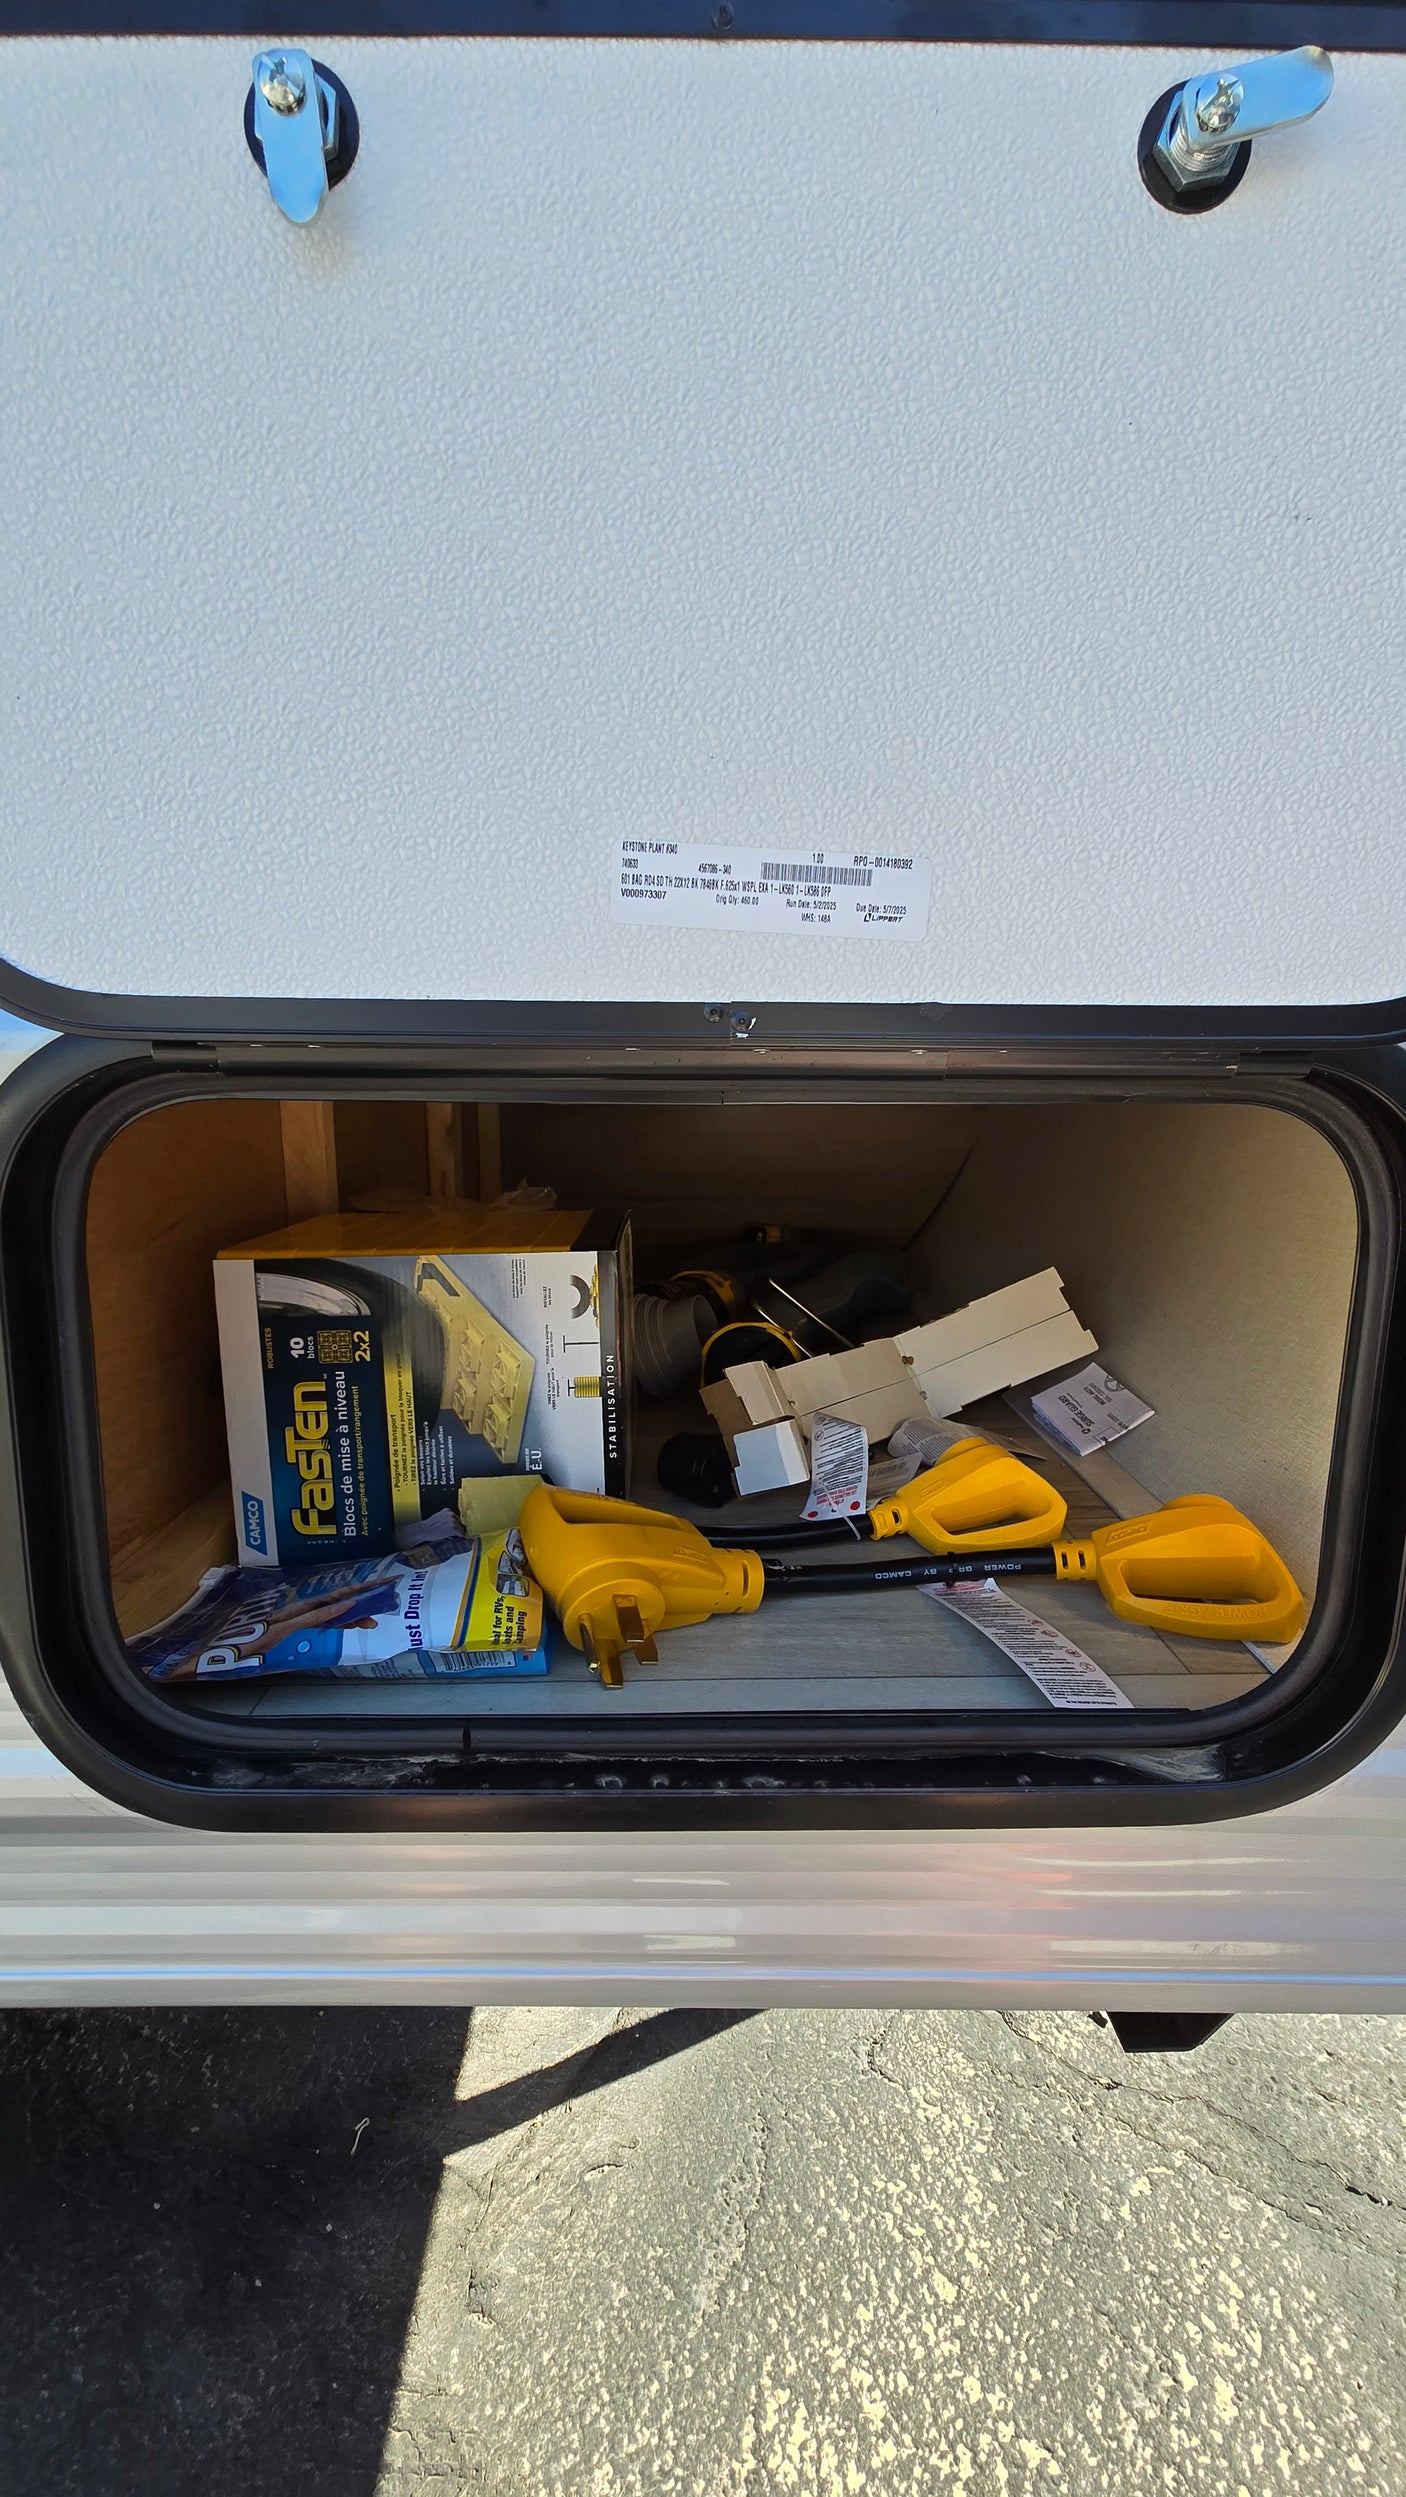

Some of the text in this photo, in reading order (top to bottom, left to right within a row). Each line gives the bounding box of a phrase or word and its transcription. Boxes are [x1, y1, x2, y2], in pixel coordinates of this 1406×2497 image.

[622, 841, 678, 854] KEYSTONE PLANT #340
[812, 853, 824, 863] 1.00
[632, 875, 643, 885] BAG
[665, 876, 672, 886] TH
[674, 877, 690, 888] 22X12
[691, 878, 698, 889] BK
[786, 899, 837, 910] Run Date: 5/2/2025
[856, 902, 866, 912] Due
[868, 904, 881, 914] Date:
[801, 913, 816, 922] WHS:
[872, 915, 903, 923] LIPPERT
[264, 1328, 274, 1369] ROBUSTES
[290, 1337, 305, 1358] 10
[306, 1336, 315, 1359] blocs
[354, 1331, 371, 1362] 2x2
[606, 1354, 617, 1458] STABILISATION
[1058, 1395, 1078, 1412] GUARD
[1073, 1409, 1095, 1427] SURGE
[334, 1371, 357, 1536] Blocs de mise à niveau
[391, 1414, 401, 1488] Poignée de transport
[351, 1386, 369, 1536] Avec poignée de transport/rangement
[247, 1500, 261, 1545] CAMCO
[875, 1570, 912, 1579] CAMCO
[949, 1565, 972, 1573] GRP
[984, 1563, 1021, 1571] POWER
[413, 1571, 428, 1581] In!
[404, 1594, 424, 1619] Drop
[494, 1596, 505, 1614] RVs,
[1163, 1606, 1268, 1618] POWER GRIP
[493, 1615, 502, 1628] for
[504, 1606, 514, 1622] and
